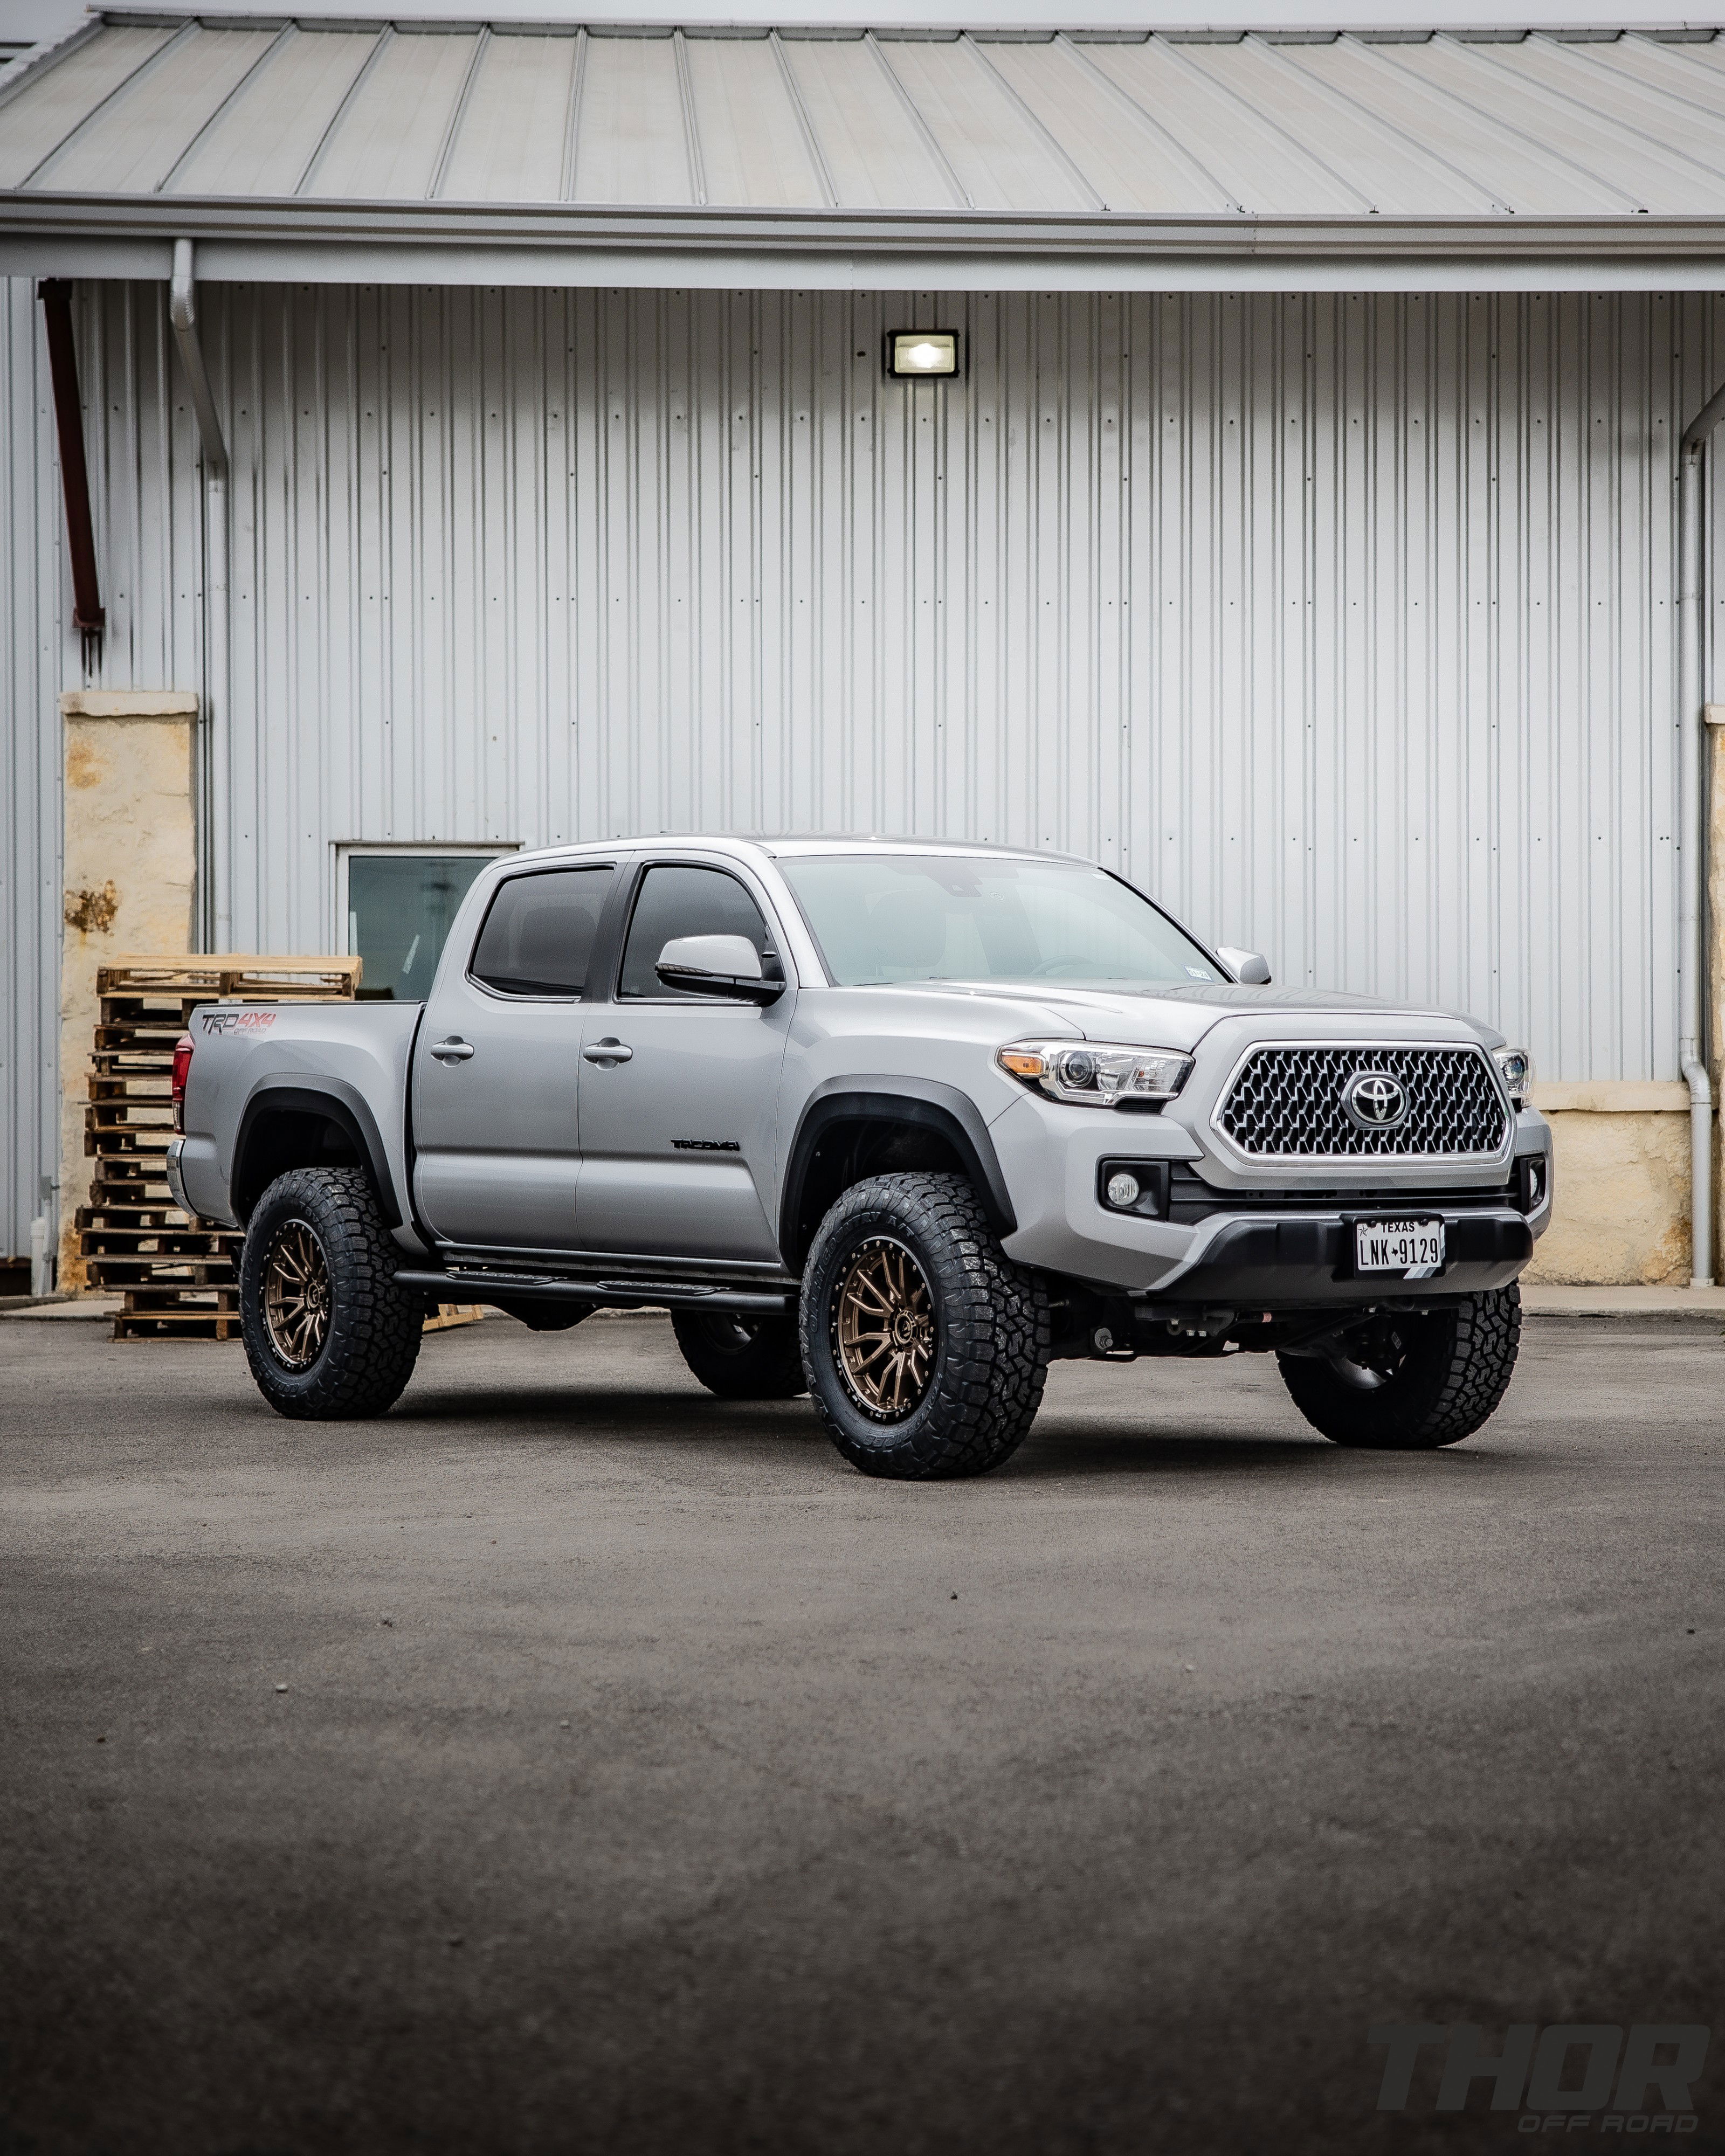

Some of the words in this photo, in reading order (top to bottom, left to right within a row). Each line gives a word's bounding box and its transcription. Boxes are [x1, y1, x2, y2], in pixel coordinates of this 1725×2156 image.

[203, 1014, 239, 1035] TRD
[670, 1138, 740, 1152] TACOMA
[1381, 1221, 1415, 1233] TEXAS
